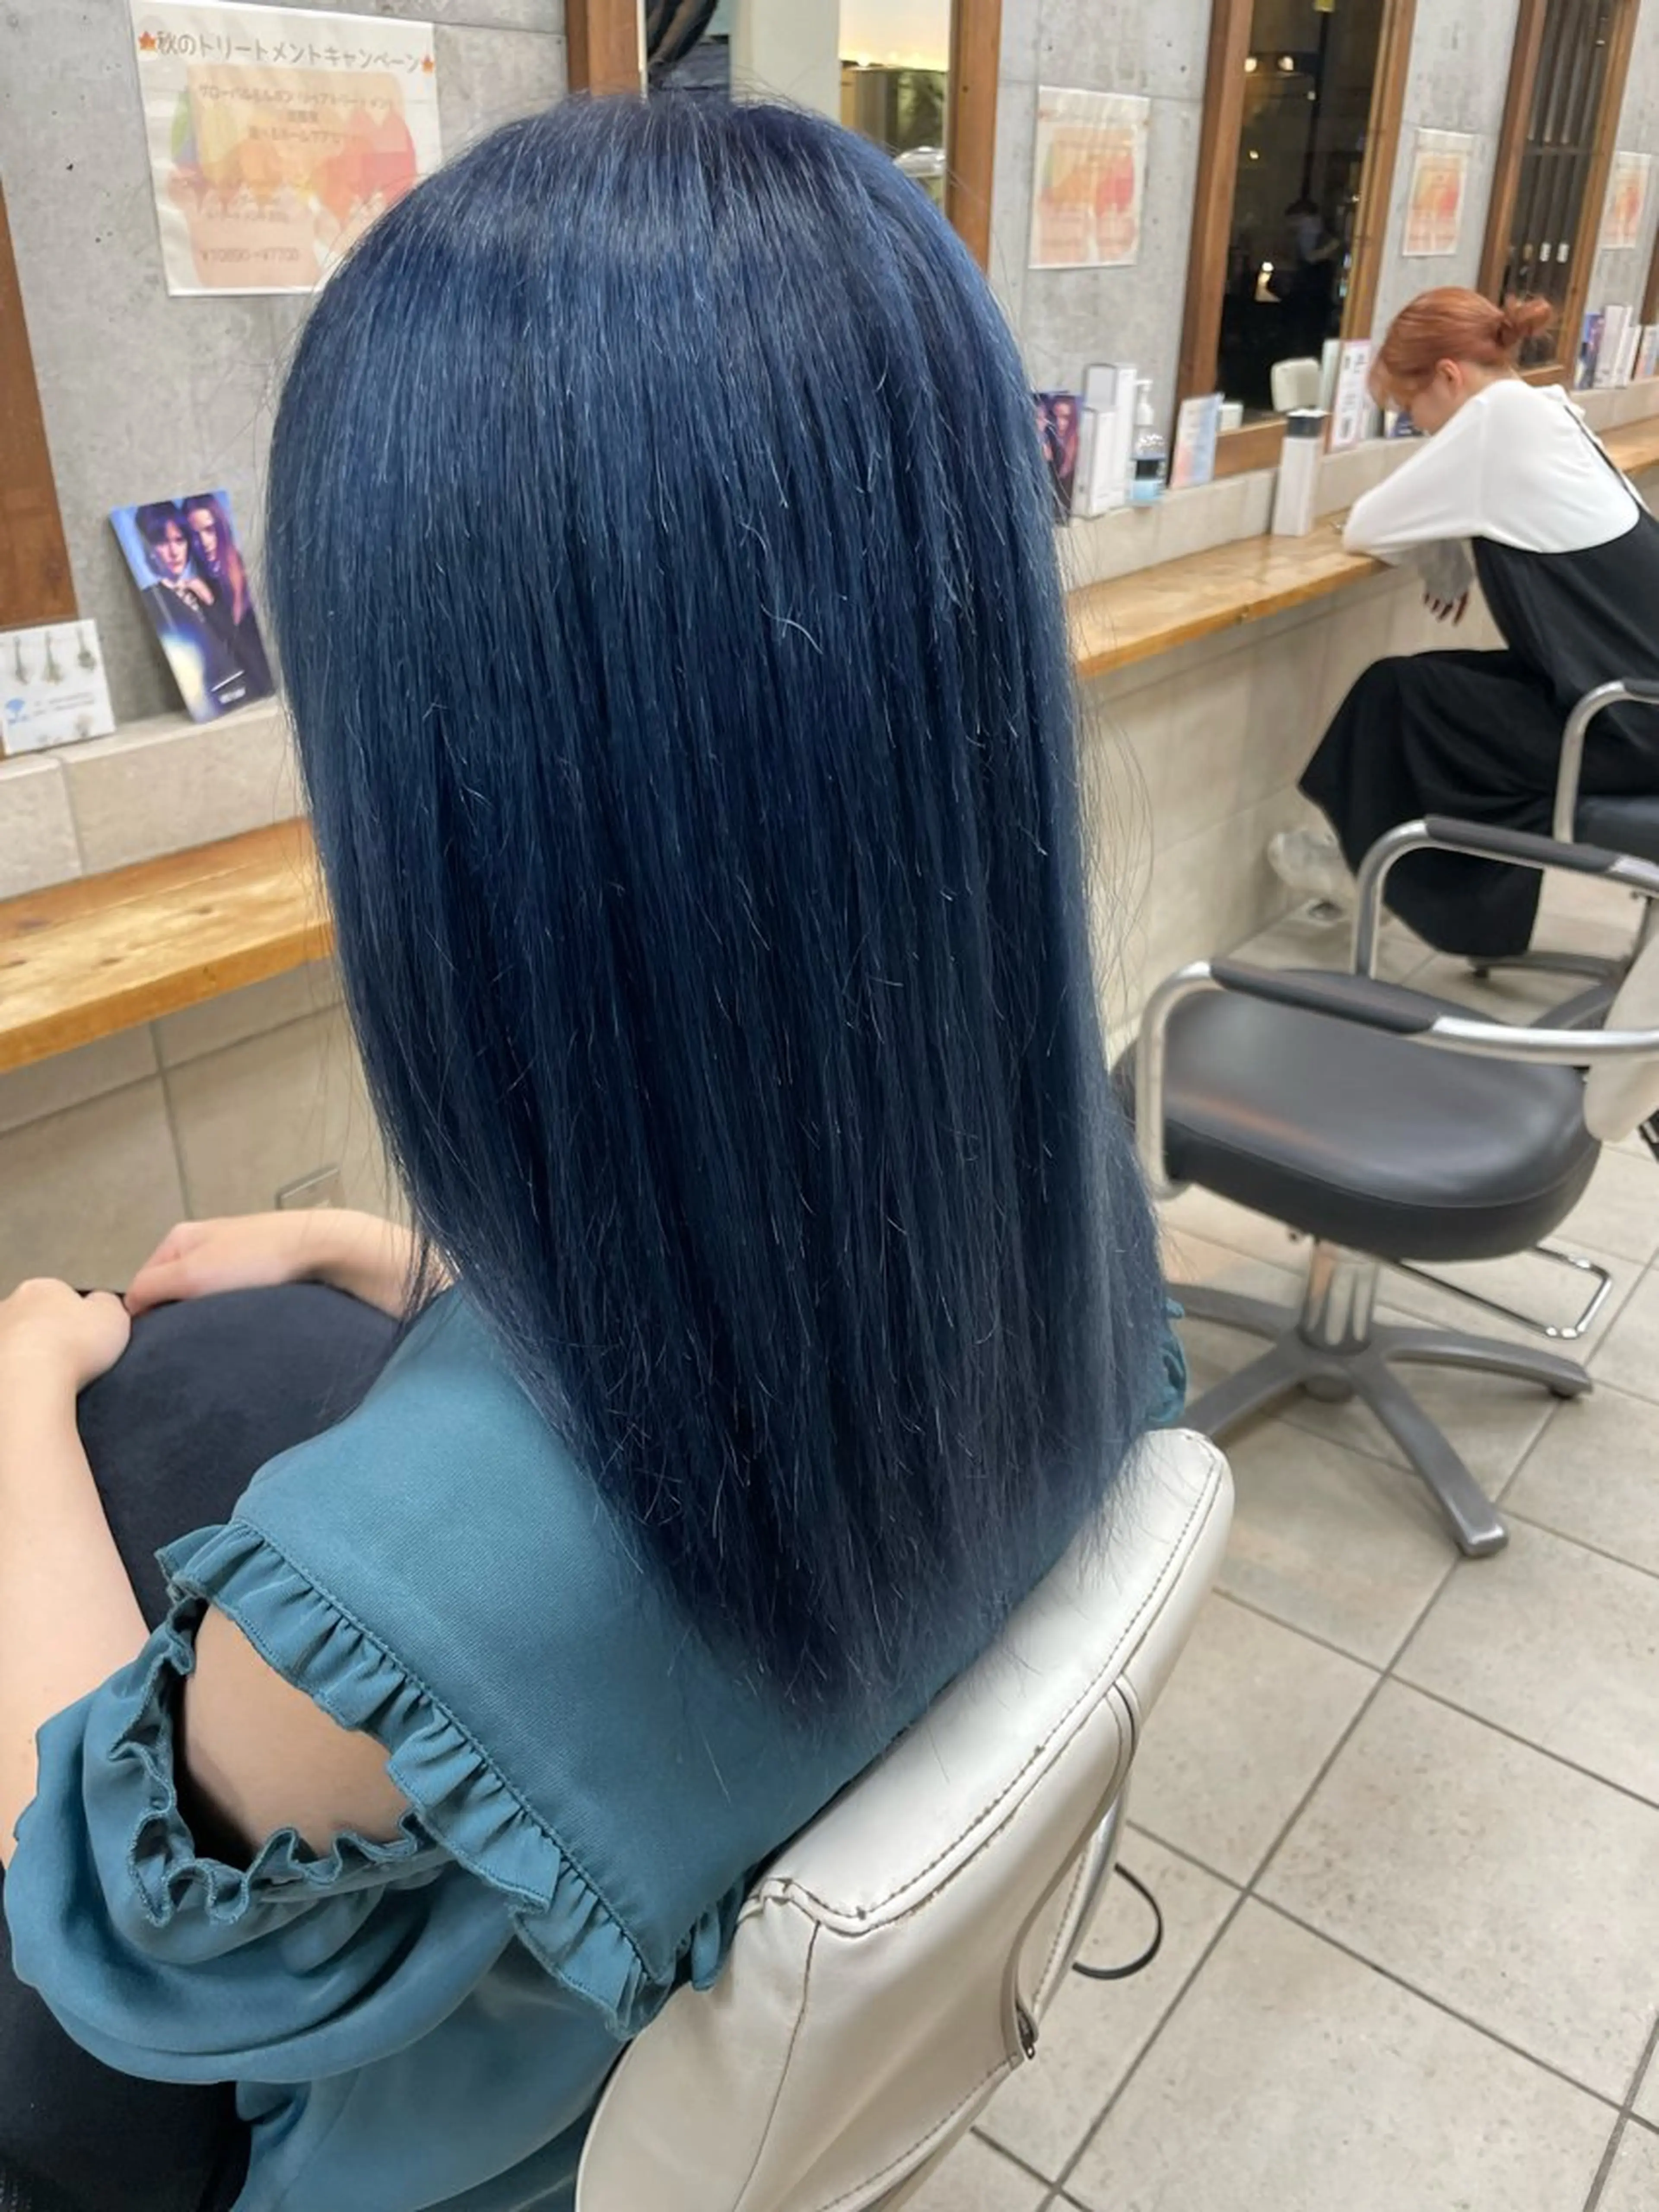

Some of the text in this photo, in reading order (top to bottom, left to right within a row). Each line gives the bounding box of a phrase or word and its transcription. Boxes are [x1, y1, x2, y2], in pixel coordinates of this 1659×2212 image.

[157, 29, 421, 73] 秋のトリートメントキャンペーン
